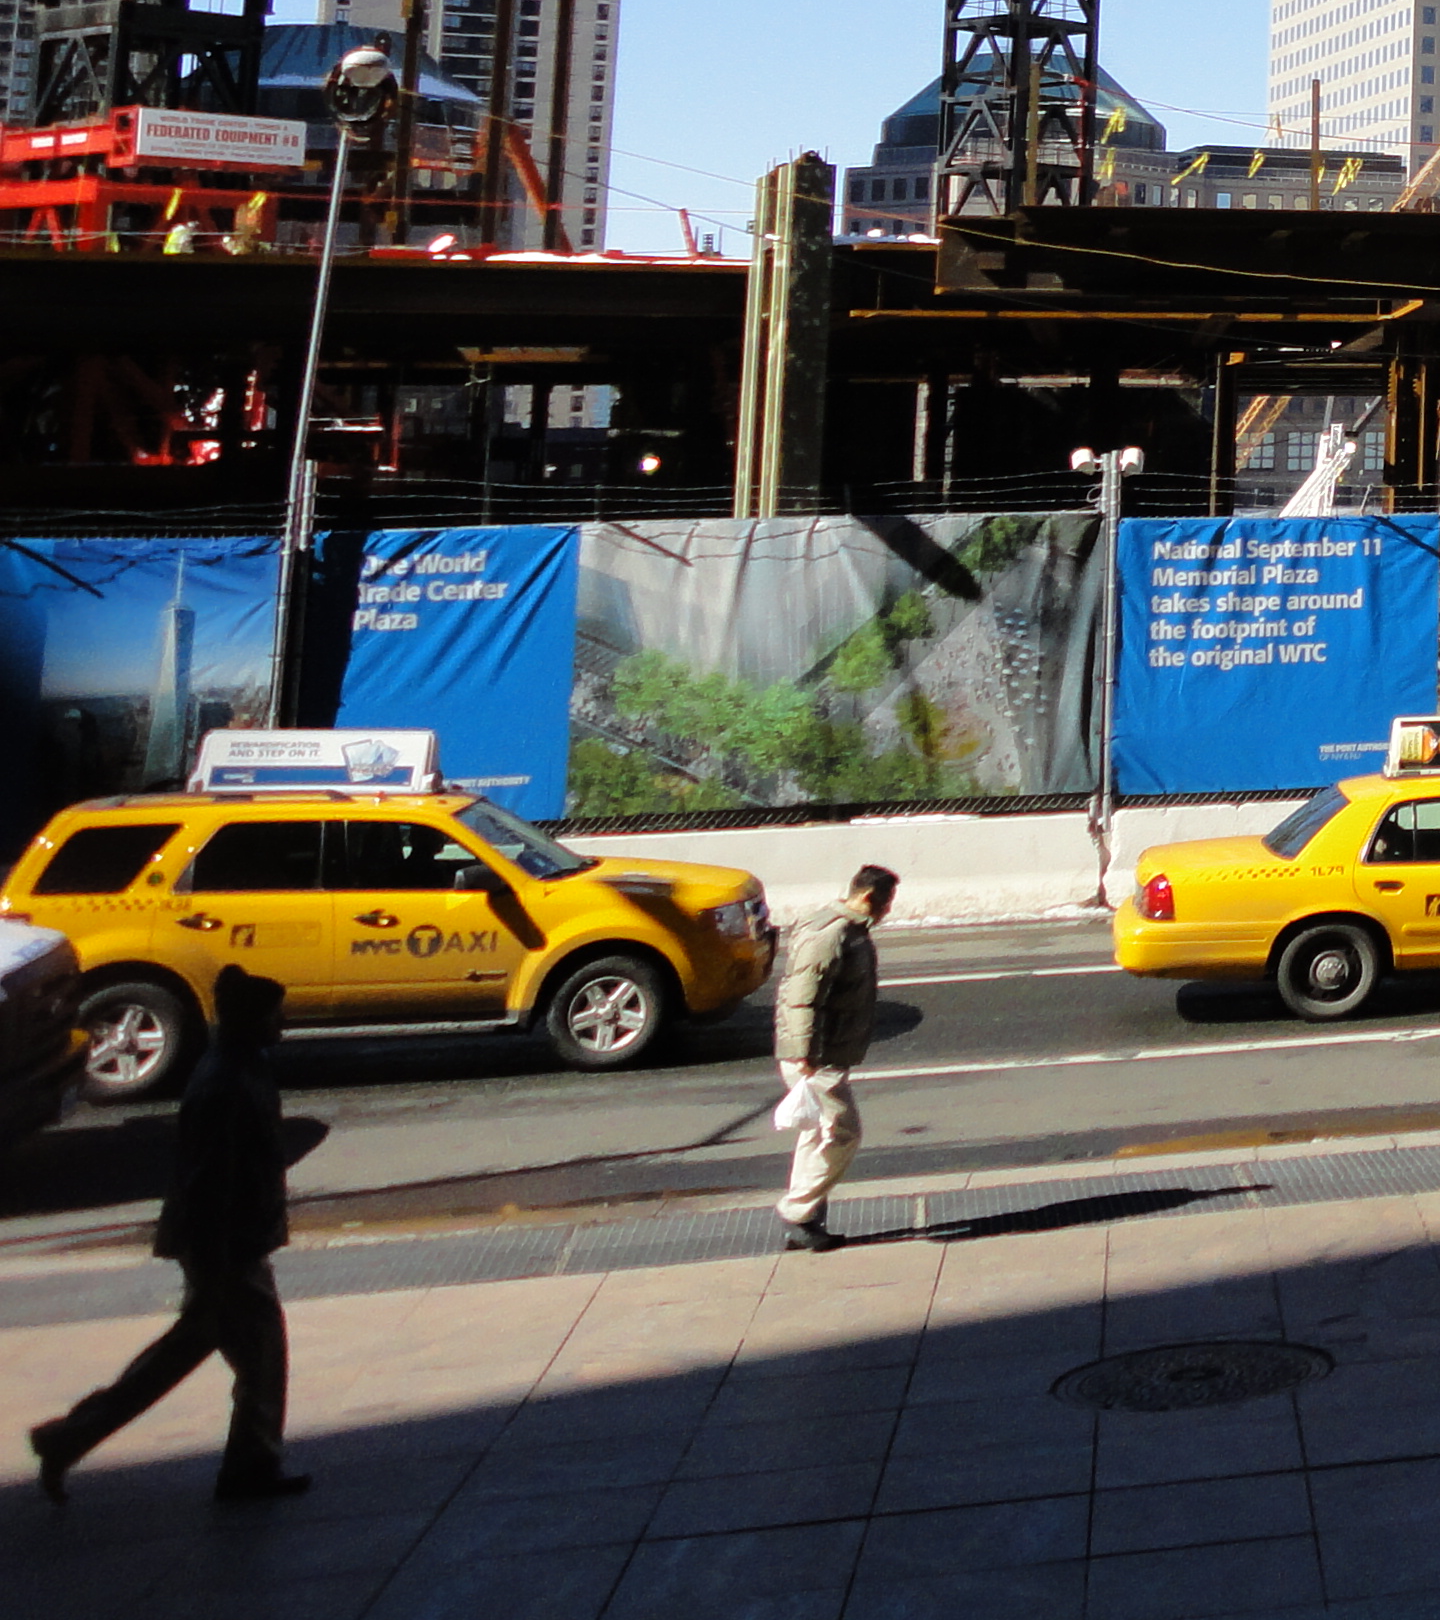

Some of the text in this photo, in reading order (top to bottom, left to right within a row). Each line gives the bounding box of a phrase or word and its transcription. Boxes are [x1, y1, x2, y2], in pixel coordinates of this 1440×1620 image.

[147, 123, 211, 141] FEDERATED
[215, 128, 278, 146] EQUIPMENT
[1153, 537, 1382, 562] National September 11
[413, 550, 489, 574] World
[1152, 564, 1319, 588] Memorial Plaza
[426, 581, 509, 601] Center
[1151, 589, 1363, 616] takes shape around
[352, 609, 418, 631] Plaza
[1150, 616, 1316, 643] the footprint of
[1149, 643, 1327, 670] the original WTC
[1310, 866, 1345, 878] 1L79
[350, 925, 499, 959] NYC TAXI
